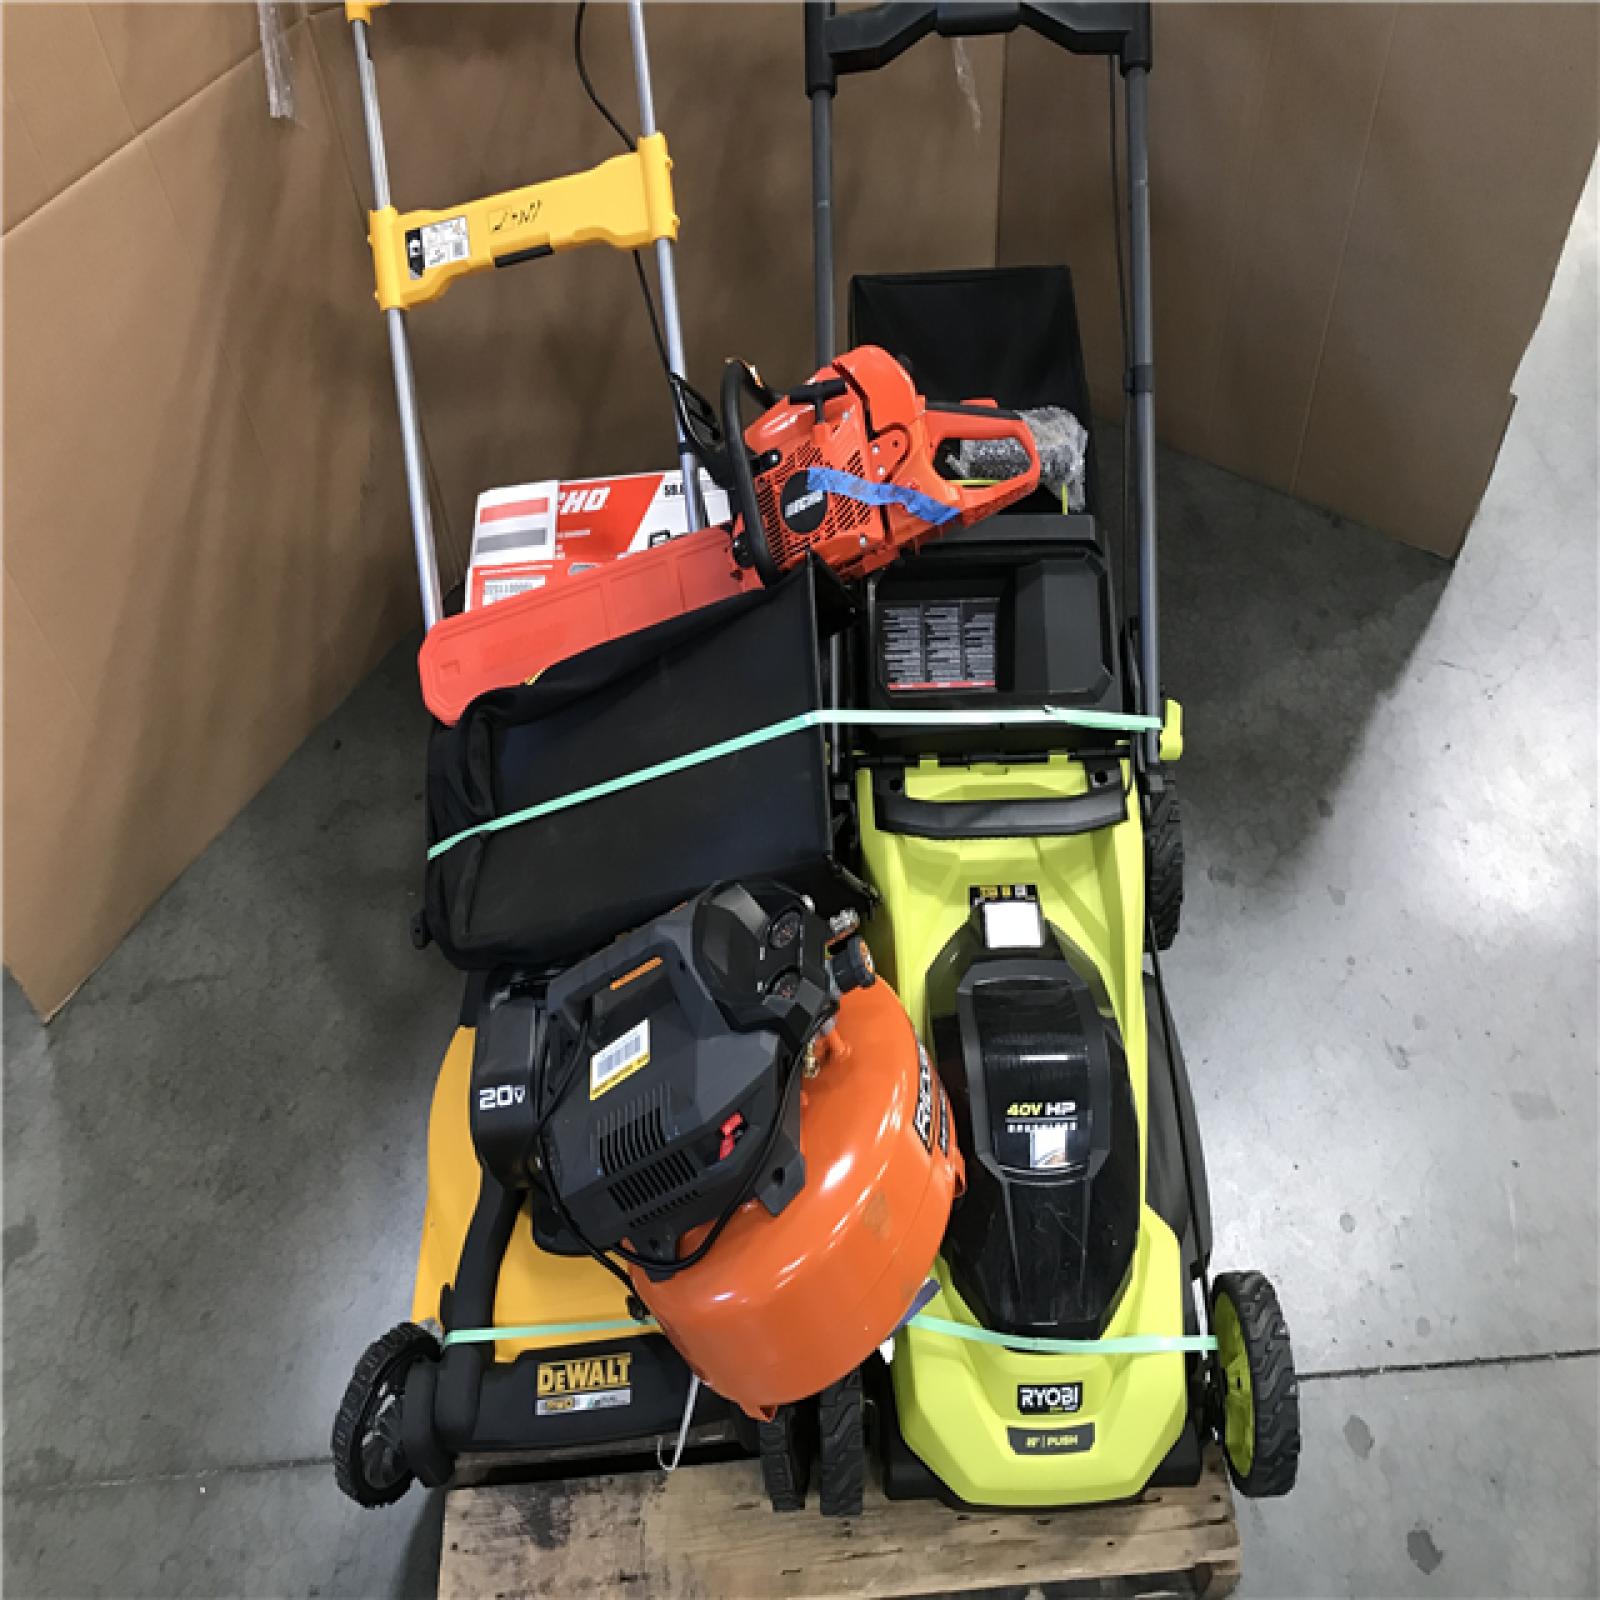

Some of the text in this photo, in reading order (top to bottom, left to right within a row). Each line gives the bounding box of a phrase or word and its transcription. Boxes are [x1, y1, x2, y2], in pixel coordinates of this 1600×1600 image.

[1007, 1101, 1076, 1116] 40V HP
[1020, 1385, 1079, 1407] RYOBI
